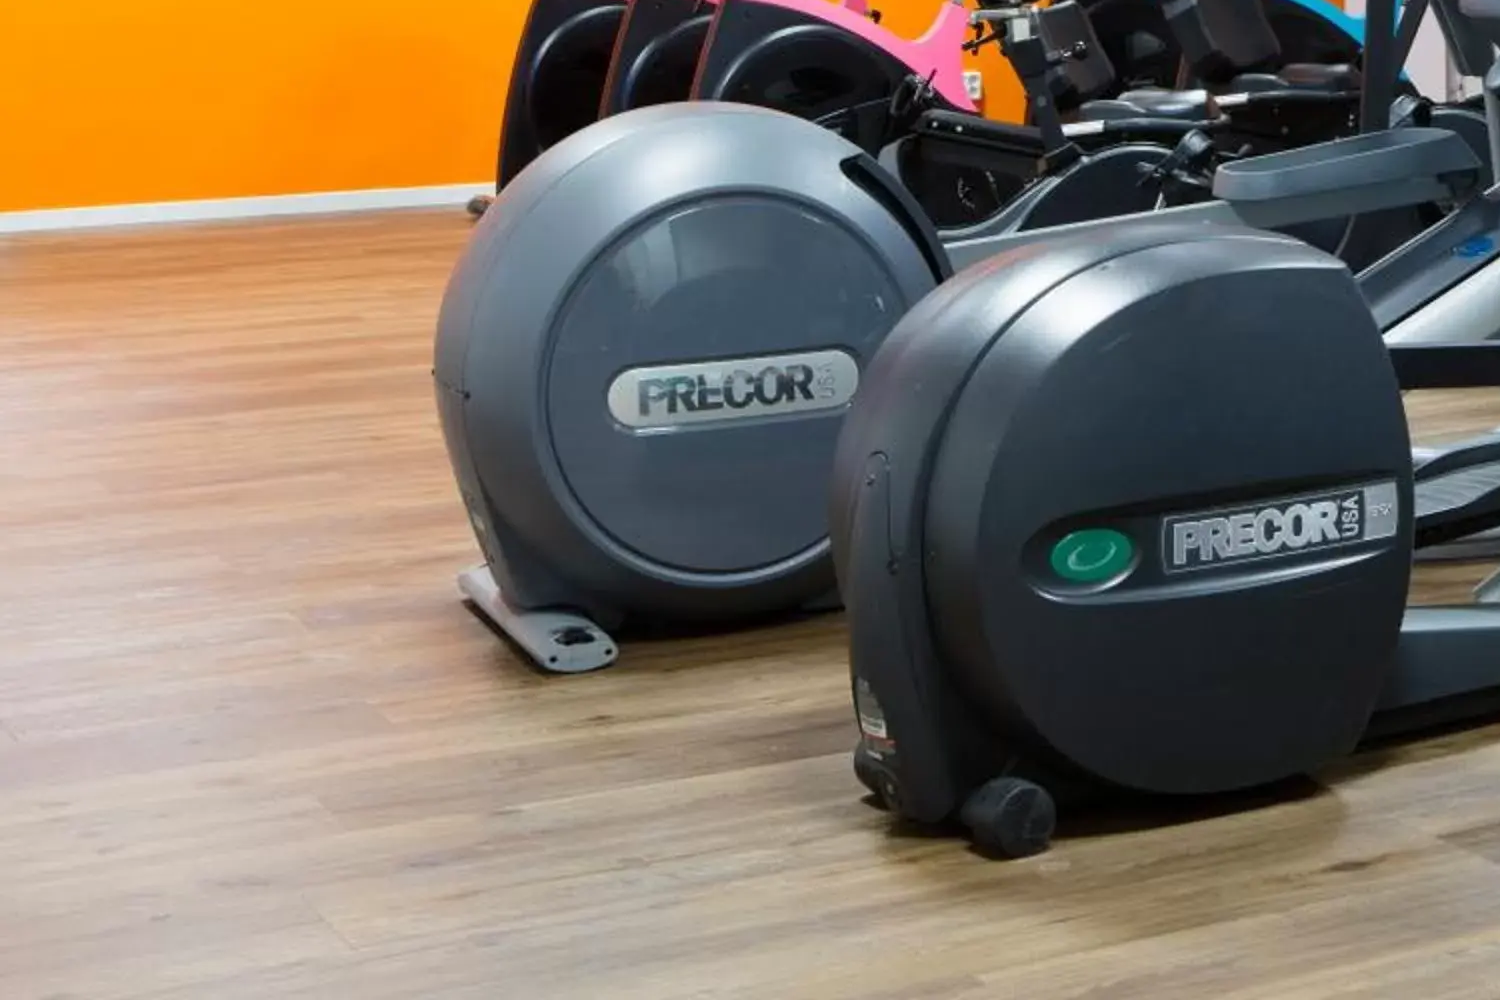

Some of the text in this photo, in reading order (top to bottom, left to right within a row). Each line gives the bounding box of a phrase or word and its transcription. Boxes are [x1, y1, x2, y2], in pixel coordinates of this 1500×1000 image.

[637, 363, 814, 417] PRECOR
[1173, 494, 1359, 566] PRECOR USA
